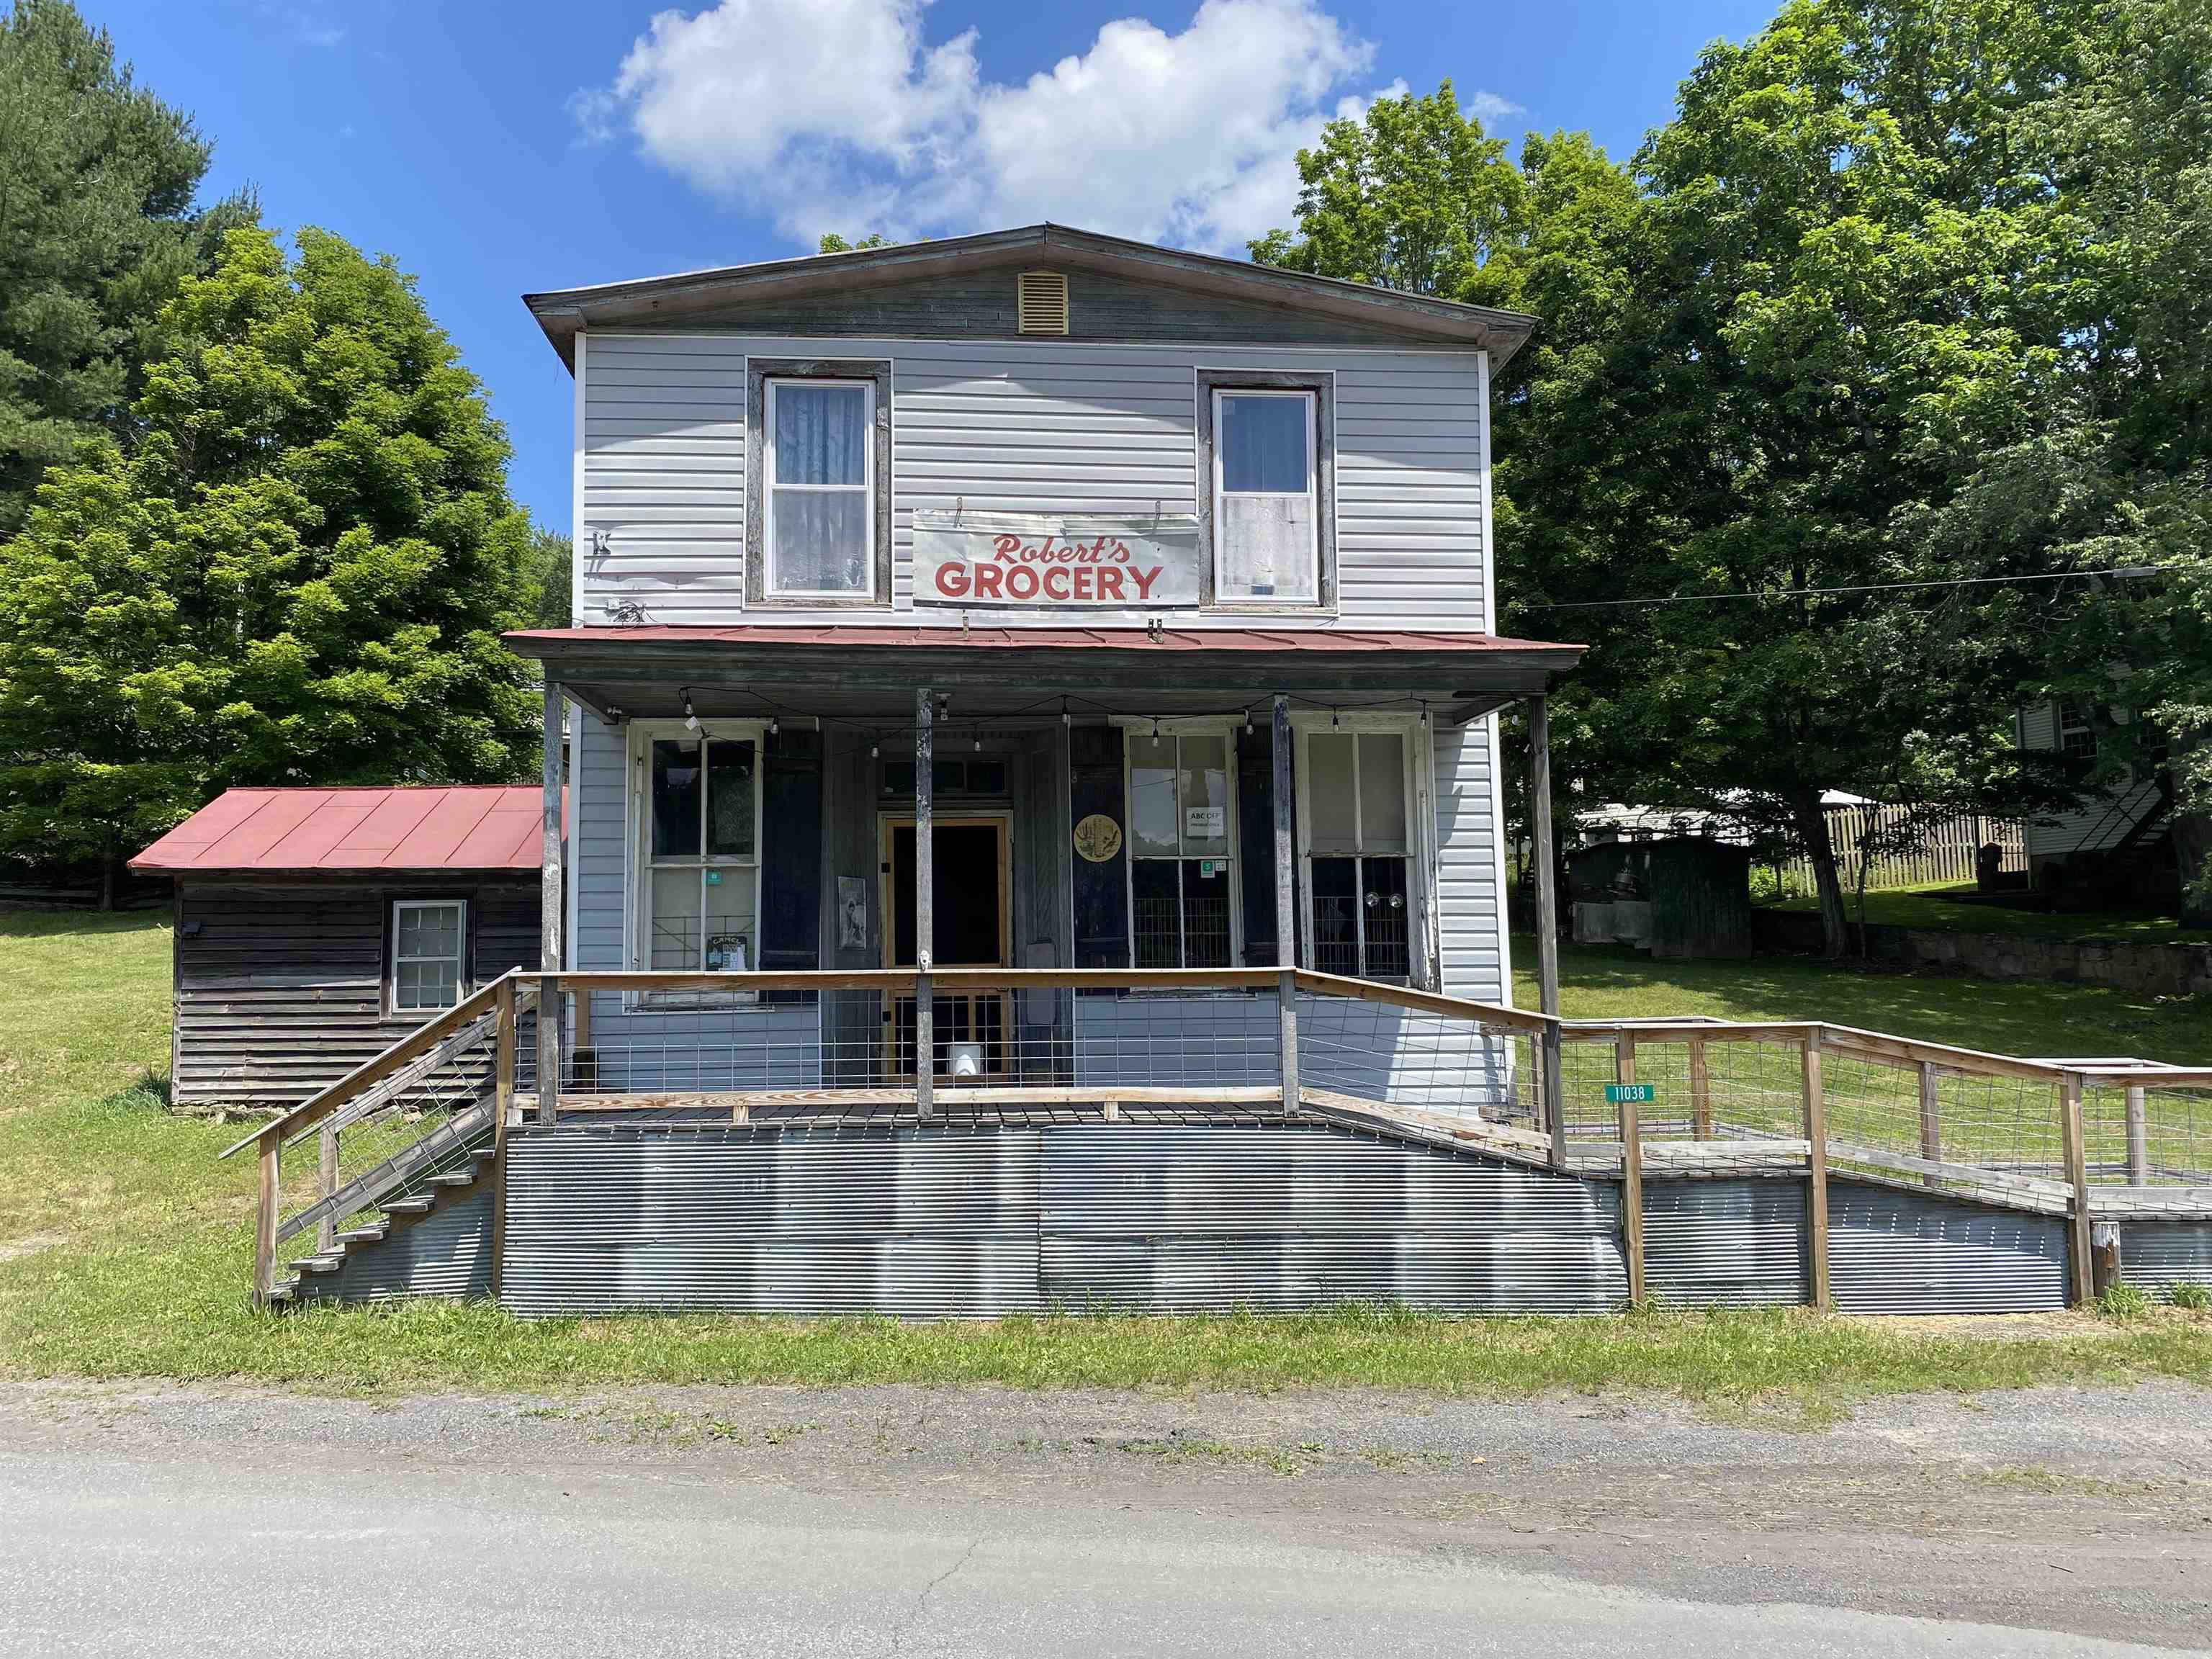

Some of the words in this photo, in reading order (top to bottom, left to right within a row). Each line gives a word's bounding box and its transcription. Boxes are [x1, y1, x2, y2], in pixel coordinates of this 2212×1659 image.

[993, 534, 1130, 564] Robert's
[935, 562, 1164, 600] GROCERY
[1615, 1086, 1645, 1100] 11038
